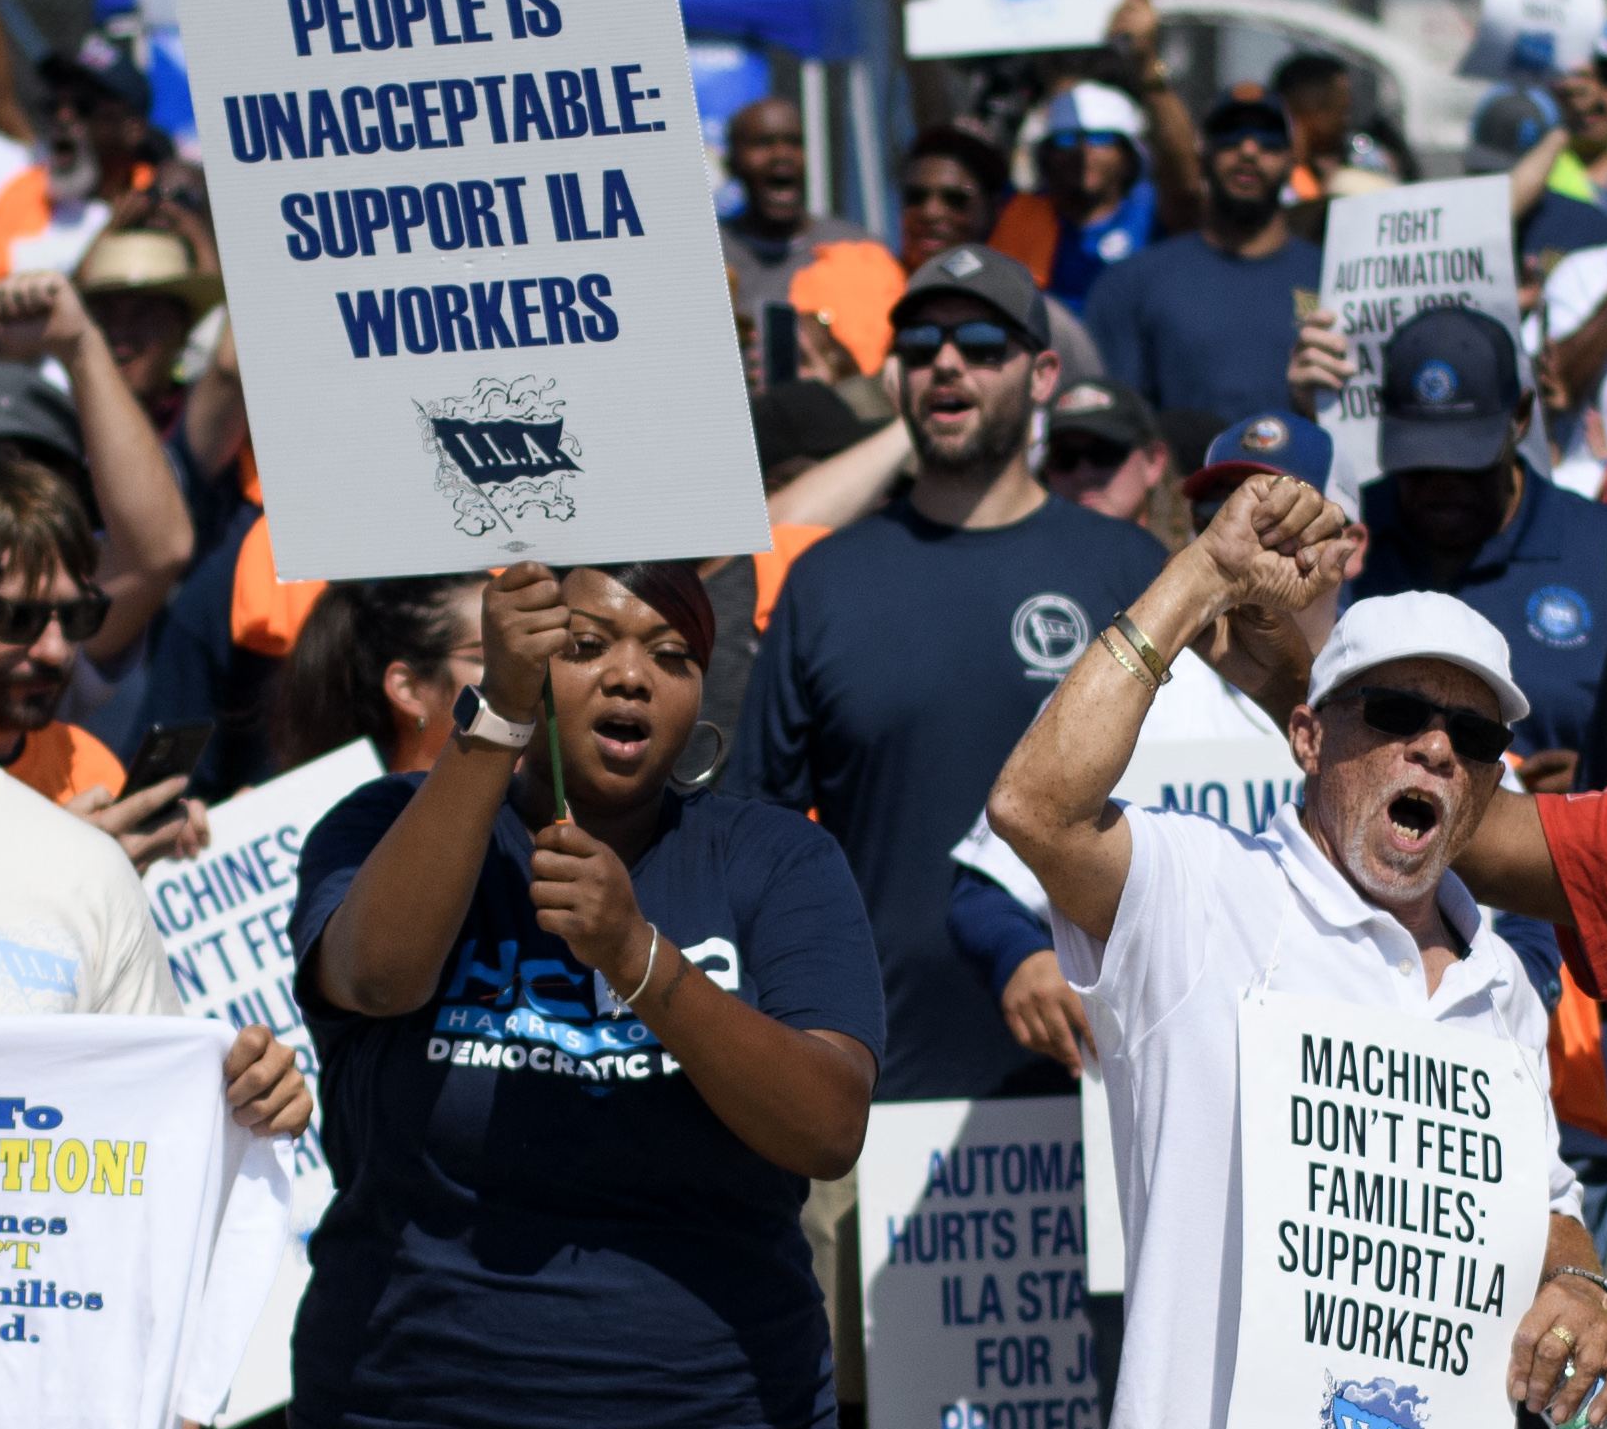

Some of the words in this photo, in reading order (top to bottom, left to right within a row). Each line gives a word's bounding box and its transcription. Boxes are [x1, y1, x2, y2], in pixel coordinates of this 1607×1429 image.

[223, 63, 668, 164] UNACCEPTABLE:
[279, 175, 531, 262] SUPPORT
[544, 168, 645, 243] ILA
[1376, 207, 1444, 248] FIGHT
[1333, 246, 1495, 294] AUTOMATION,
[335, 273, 620, 360] WORKERS
[1342, 296, 1403, 336] SAVE
[454, 431, 563, 468] I.L.A.
[167, 928, 237, 1004] N'T
[426, 1036, 652, 1081] DEMOCRATIC
[448, 1009, 583, 1050] HARRIS
[1300, 1032, 1491, 1121] MACHINES
[1289, 1093, 1404, 1164] DON'T
[1415, 1117, 1503, 1185] FEED
[924, 1140, 1084, 1200] AUTOMA
[1307, 1160, 1487, 1246] FAMILIES:
[886, 1208, 1018, 1265] HURTS
[941, 1274, 1005, 1327] ILA
[1016, 1269, 1088, 1324] STA
[1277, 1219, 1446, 1303] SUPPORT
[1454, 1254, 1506, 1318] ILA
[976, 1335, 1053, 1390] FOR
[1303, 1288, 1474, 1377] WORKERS
